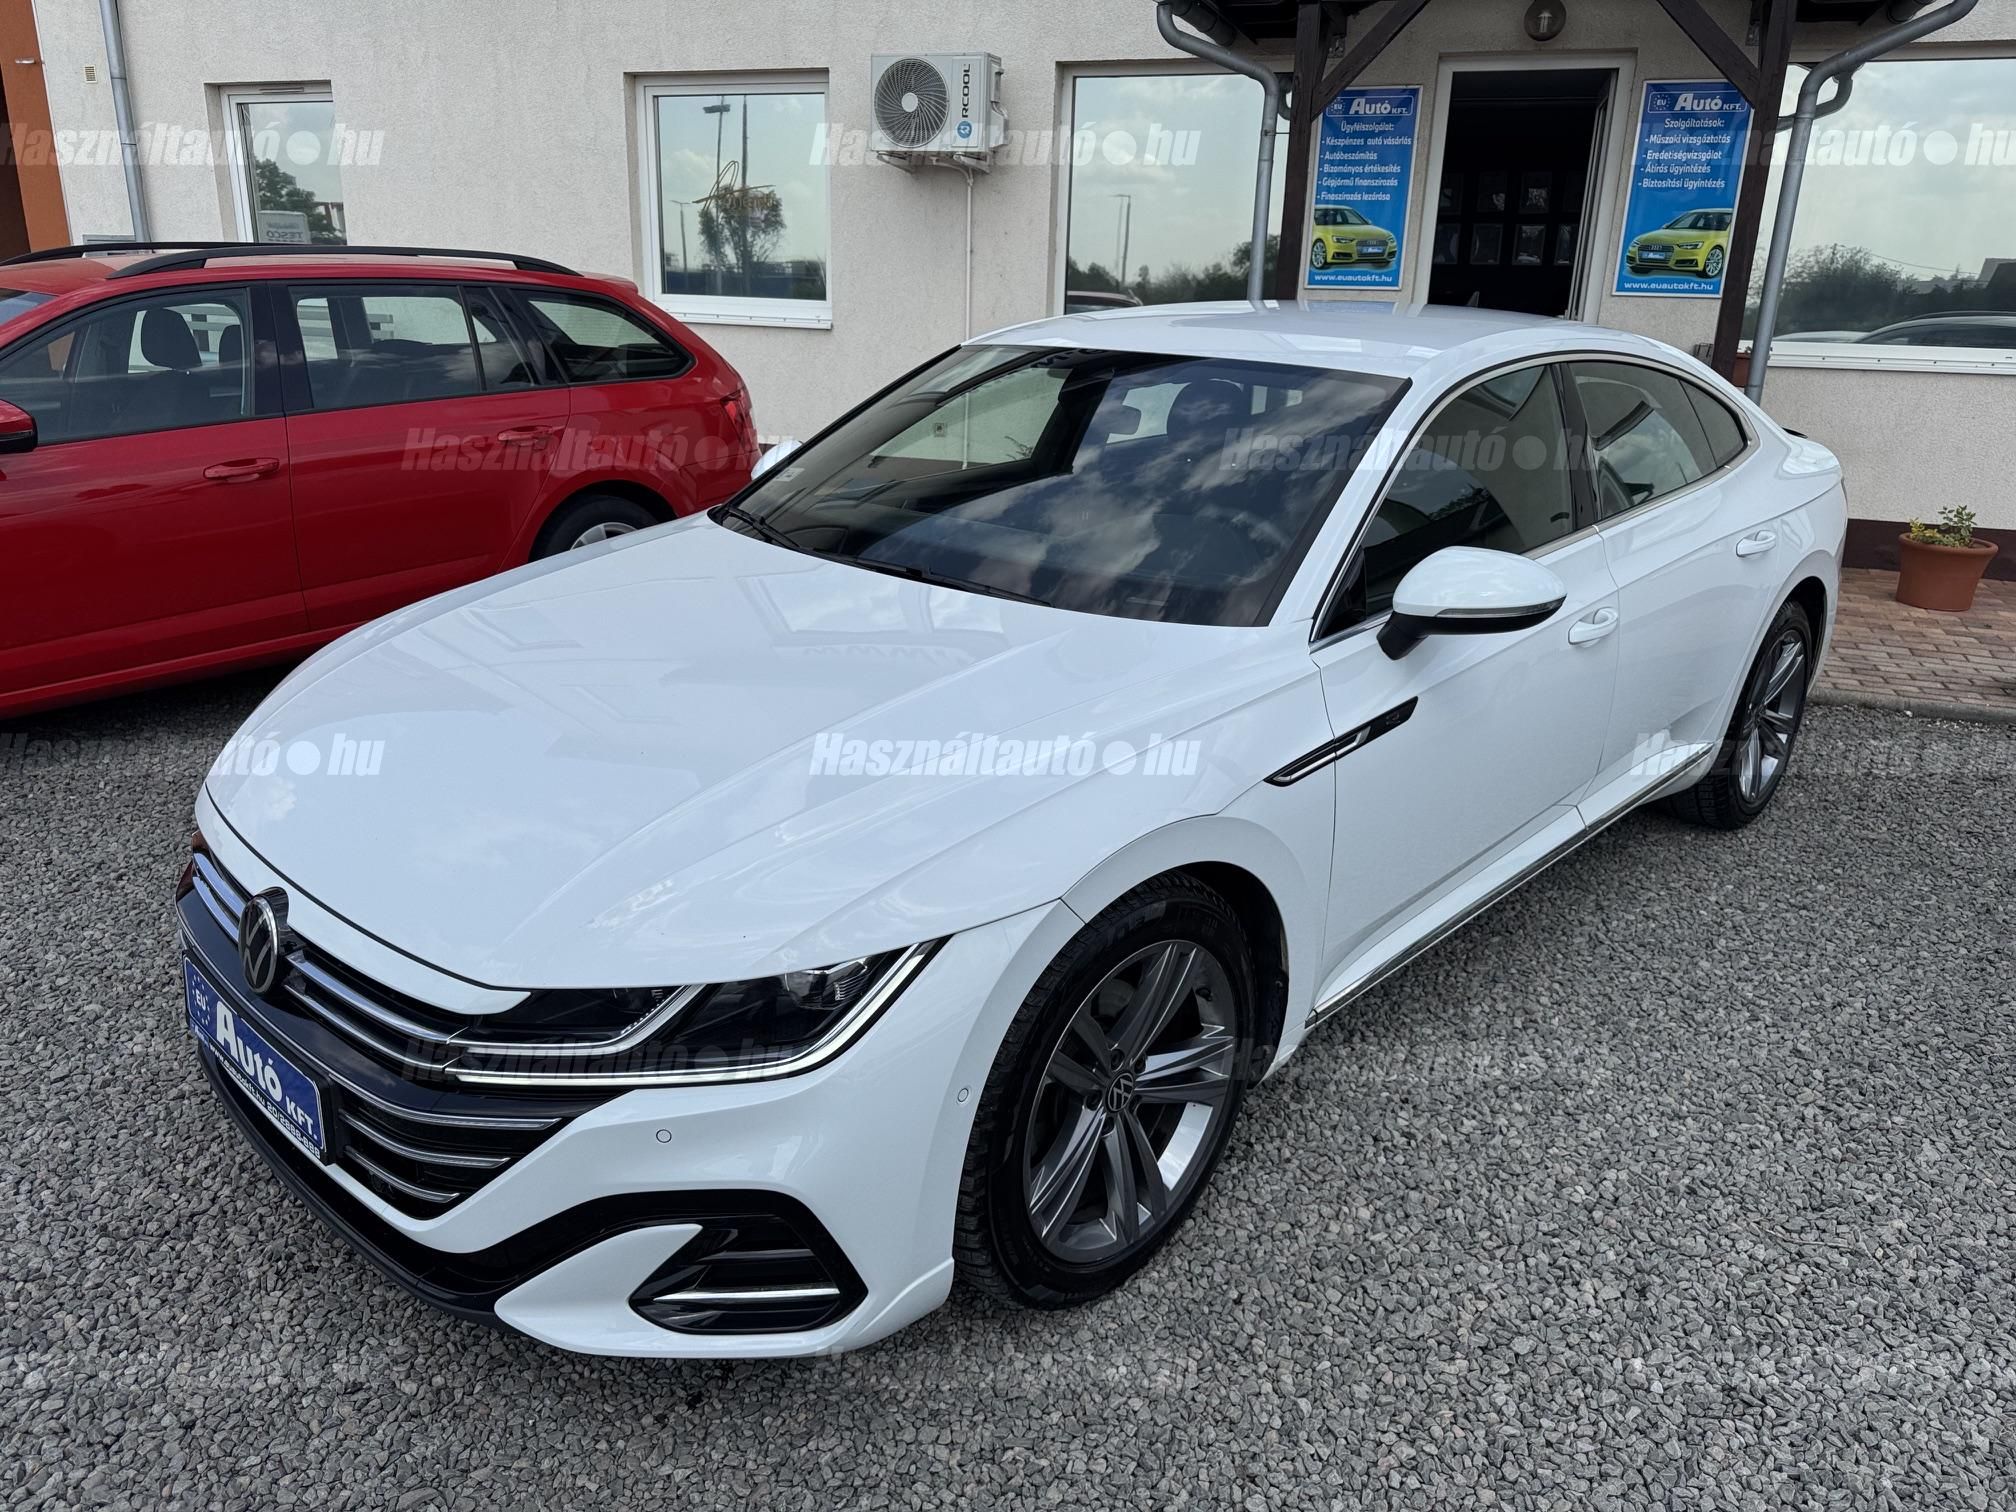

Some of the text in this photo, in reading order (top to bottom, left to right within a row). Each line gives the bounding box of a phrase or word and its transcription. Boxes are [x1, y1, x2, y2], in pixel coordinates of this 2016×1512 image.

[961, 63, 971, 118] RCOOL
[1348, 98, 1391, 115] Autó
[1673, 93, 1723, 111] Autó
[1722, 103, 1742, 111] KFT.
[1664, 118, 1725, 130] Szolgáltatások:
[1367, 136, 1382, 145] autó
[1682, 134, 1731, 145] vizsgáztatás
[1314, 273, 1393, 283] www.euautokft.hu
[1623, 281, 1714, 291] www.euautokft.hu
[195, 988, 206, 1011] EU
[216, 1000, 283, 1102] Autó
[285, 1095, 318, 1141] KFT.
